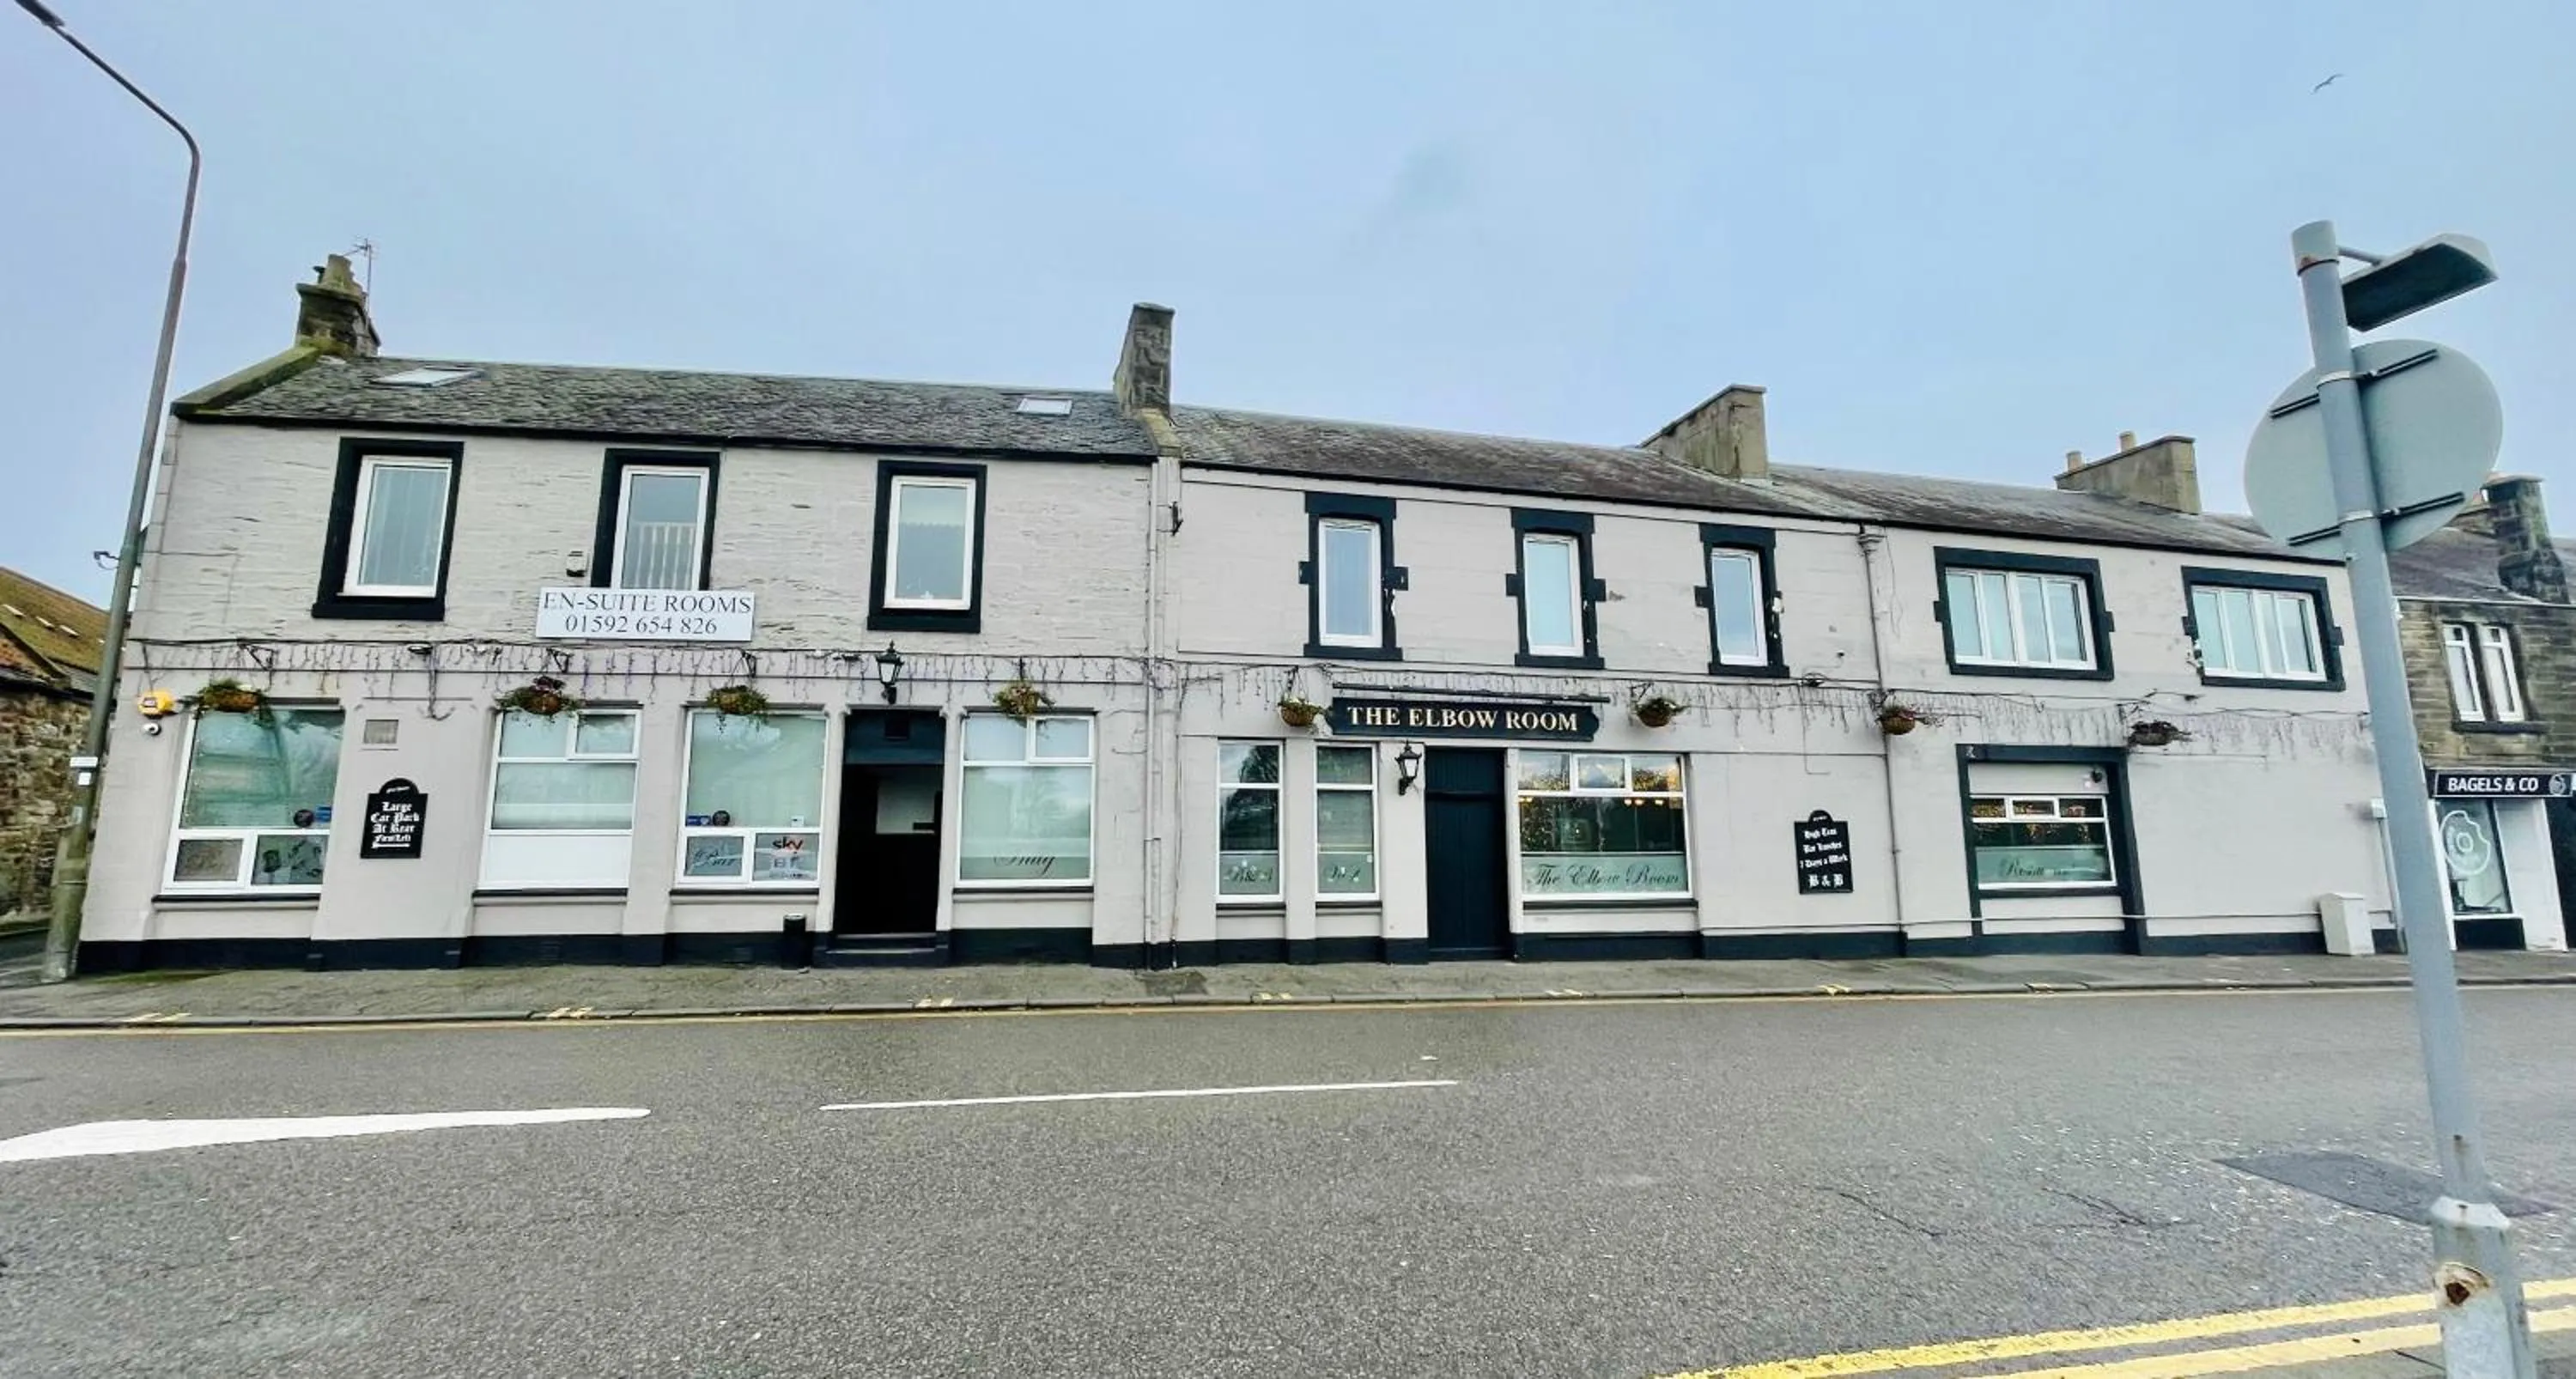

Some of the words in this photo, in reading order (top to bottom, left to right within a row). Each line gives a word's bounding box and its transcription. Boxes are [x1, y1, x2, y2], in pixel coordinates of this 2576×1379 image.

[544, 592, 657, 612] EN-SUITE
[664, 595, 751, 614] ROOMS
[565, 614, 629, 633] 01592
[635, 617, 672, 635] 654
[679, 617, 718, 635] 826
[1347, 707, 1400, 726] THE
[1408, 708, 1498, 729] ELBOW
[1505, 711, 1577, 731] ROOM
[2448, 777, 2502, 792] BAGELS
[2505, 777, 2516, 792] &
[2518, 777, 2539, 792] CO
[381, 801, 413, 813] Large
[370, 811, 391, 823] Car
[394, 811, 420, 823] Park
[372, 823, 387, 834] At
[389, 823, 416, 834] Rear
[772, 836, 804, 854] sky
[1528, 863, 1561, 886] The
[1566, 864, 1620, 886] Elbow
[1625, 864, 1680, 886] Room
[1808, 874, 1820, 888] B
[1821, 875, 1832, 887] &
[1833, 873, 1844, 888] B
